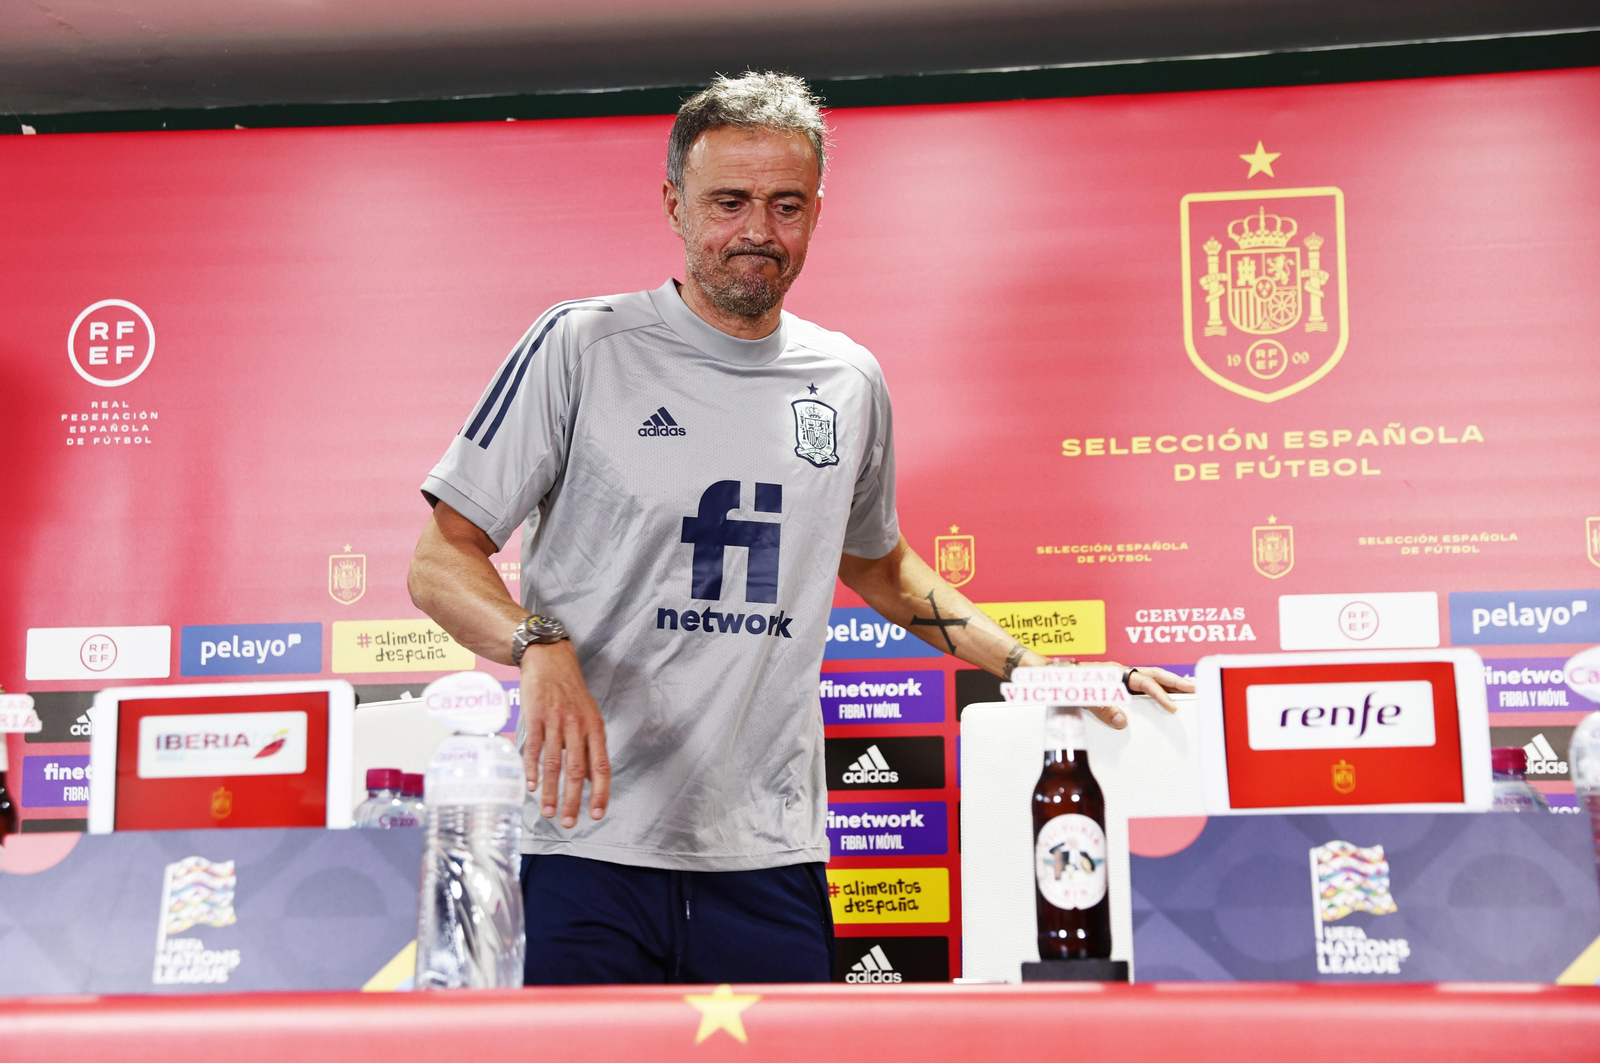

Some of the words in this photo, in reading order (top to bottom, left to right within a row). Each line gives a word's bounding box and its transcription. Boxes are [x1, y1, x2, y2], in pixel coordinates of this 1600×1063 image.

[91, 400, 130, 410] REAL
[61, 410, 159, 422] FEDERACIÓN
[69, 423, 150, 434] ESPAÑOLA
[637, 425, 687, 438] adidas
[66, 437, 85, 446] DE
[93, 435, 153, 446] FÚTBOL
[1061, 427, 1269, 458] SELECCIÓN
[1283, 421, 1485, 450] ESPAÑOLA
[1173, 462, 1221, 482] DE
[1235, 454, 1382, 480] FÚTBOL
[680, 479, 783, 605] fi
[1358, 533, 1438, 546] SELECCIÓN
[1442, 531, 1519, 544] ESPAÑOLA
[1036, 543, 1113, 555] SELECCIÓN
[1116, 541, 1189, 553] ESPAÑOLA
[1401, 546, 1421, 556] DE
[1424, 543, 1480, 555] FÚTBOL
[1077, 555, 1096, 564] DE
[1099, 553, 1153, 564] FÚTBOL
[656, 606, 794, 639] network
[995, 612, 1077, 629] alimentos
[1135, 607, 1246, 623] CERVEZAS
[1472, 602, 1571, 635] pelayo
[1011, 630, 1075, 647] españa
[1125, 623, 1257, 644] VICTORIA
[201, 635, 286, 666] pelayo
[375, 647, 446, 663] despaña
[1015, 671, 1118, 683] CERVEZAS
[1484, 665, 1568, 685] inetwo
[819, 678, 922, 698] finetwork
[1006, 686, 1126, 702] VICTORIA
[426, 689, 502, 711] Cazorla
[1500, 690, 1529, 707] FIBRA
[1529, 690, 1537, 707] Y
[1537, 688, 1569, 707] MÓVIL
[838, 703, 866, 719] FIBRA
[866, 703, 874, 718] Y
[873, 700, 902, 718] MÓVIL
[1279, 690, 1402, 740] renfe
[156, 733, 252, 751] IBERIA
[44, 763, 93, 781] finet
[842, 768, 899, 784] adidas
[63, 786, 90, 801] FIBRA
[840, 835, 868, 851] FIBRA
[868, 834, 875, 850] Y
[875, 832, 904, 850] MÓVIL
[844, 898, 919, 915] despaña
[1316, 938, 1411, 959] NATIONS
[1317, 955, 1401, 975] LEAGUE
[845, 970, 902, 984] adidas
